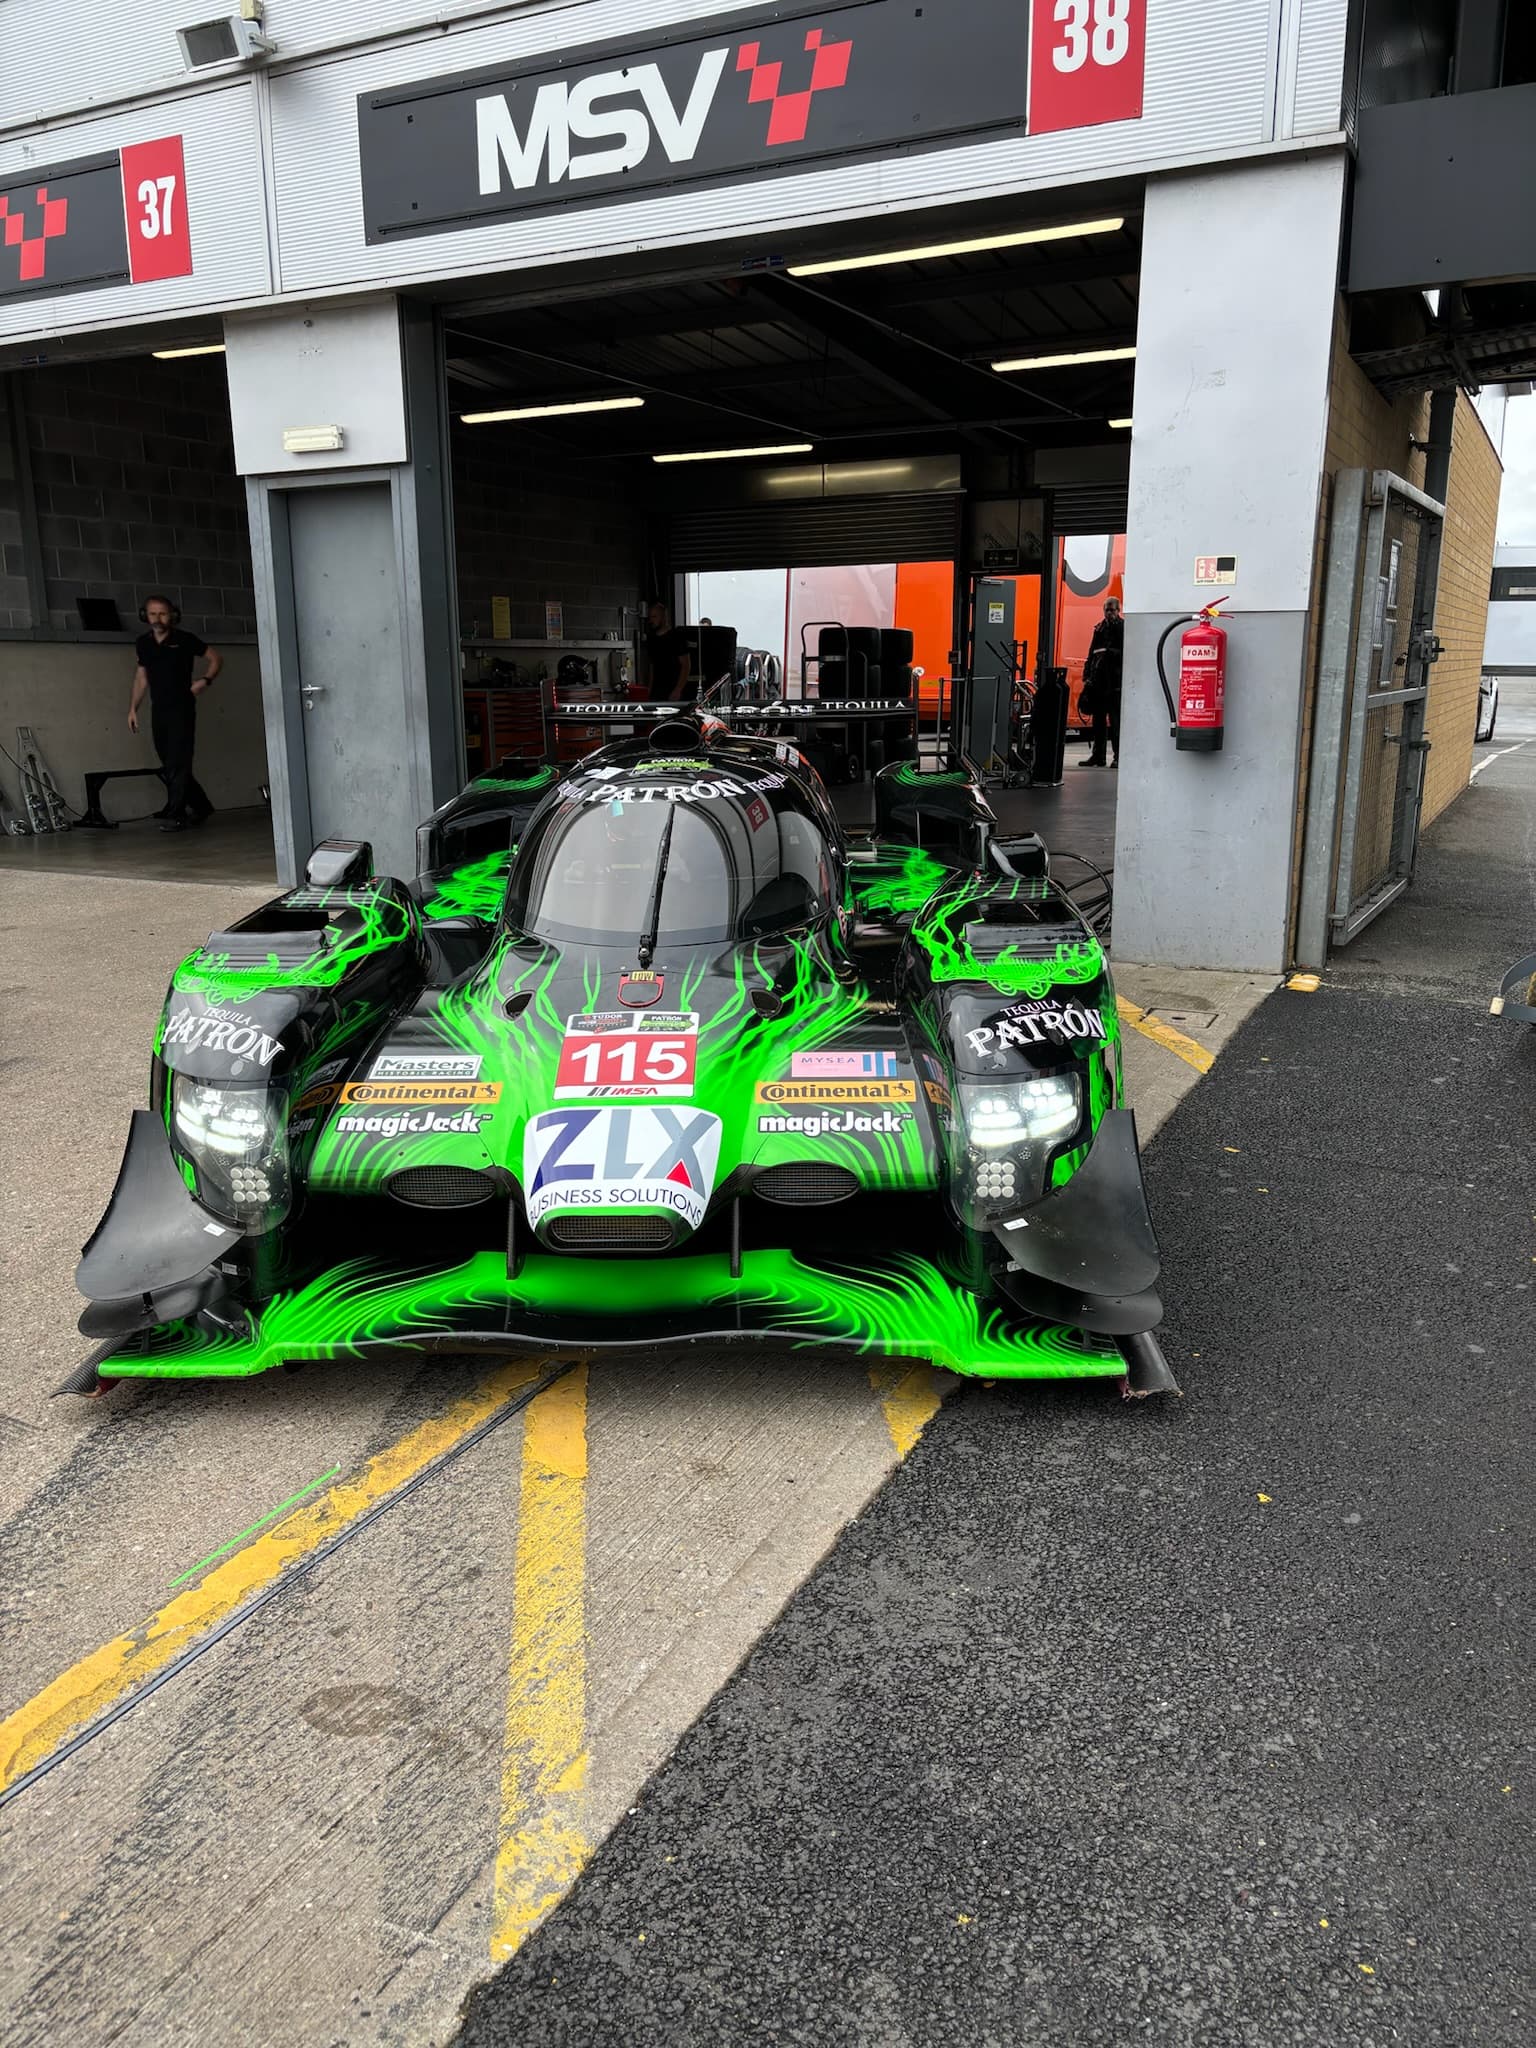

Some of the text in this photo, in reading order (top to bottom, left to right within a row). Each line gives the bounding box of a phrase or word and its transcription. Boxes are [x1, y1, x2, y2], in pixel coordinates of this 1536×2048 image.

[1052, 0, 1130, 73] 38
[476, 48, 729, 195] MSV
[138, 175, 176, 239] 37
[585, 778, 746, 802] PATRÓN
[203, 1007, 252, 1026] TEQUILA
[1001, 1000, 1062, 1016] TEQUILA
[161, 1015, 285, 1067] PATRÓN
[965, 1003, 1107, 1057] PATRÓN
[380, 1059, 474, 1070] Masters
[570, 1040, 688, 1083] 115
[801, 1056, 856, 1064] MYSEA
[347, 1084, 478, 1102] Continental
[610, 1087, 659, 1095] IMSA
[760, 1083, 890, 1102] Continental
[530, 1108, 719, 1201] ZLX
[608, 1188, 703, 1227] SOLUTIONS
